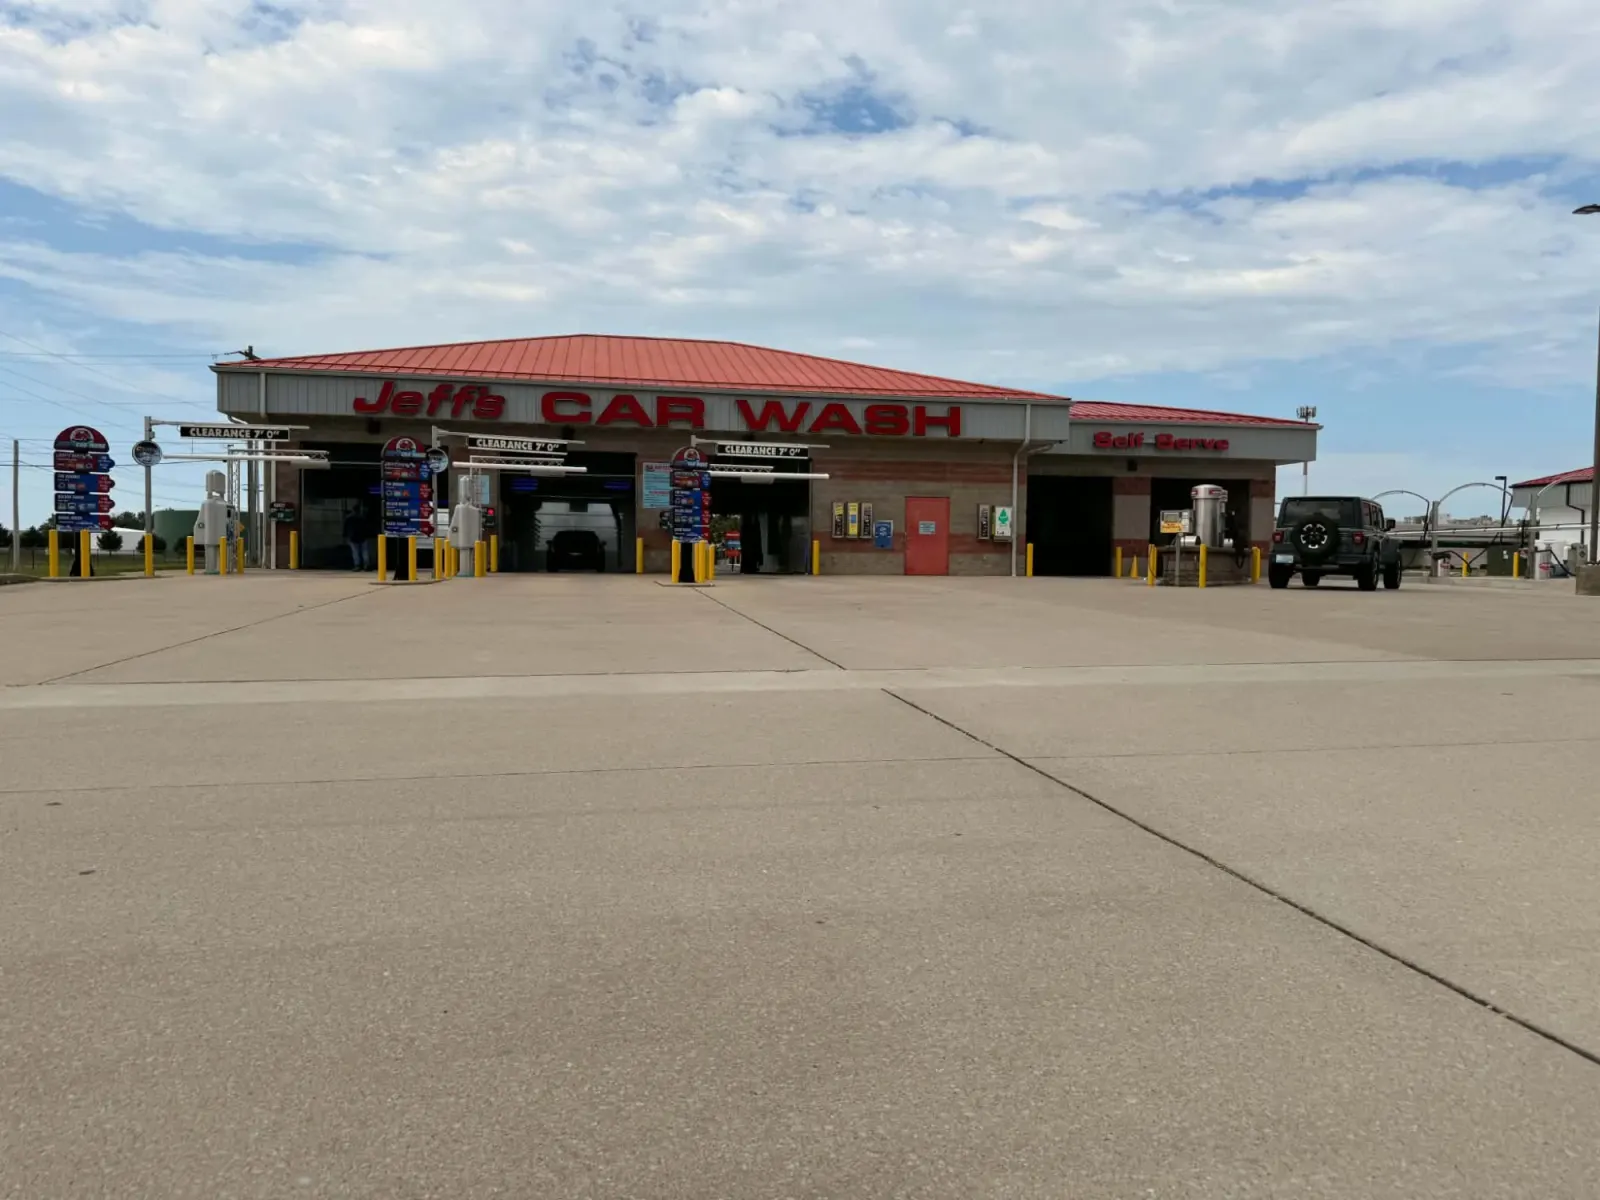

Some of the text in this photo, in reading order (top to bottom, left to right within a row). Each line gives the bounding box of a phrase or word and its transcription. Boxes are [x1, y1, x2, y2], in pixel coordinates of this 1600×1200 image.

[353, 380, 961, 437] Jeff's CAR WASH
[190, 427, 251, 438] CLEARANCE
[476, 438, 533, 450] CLEARANCE
[1093, 431, 1230, 451] Self Serve
[724, 445, 778, 456] CLEARANCE
